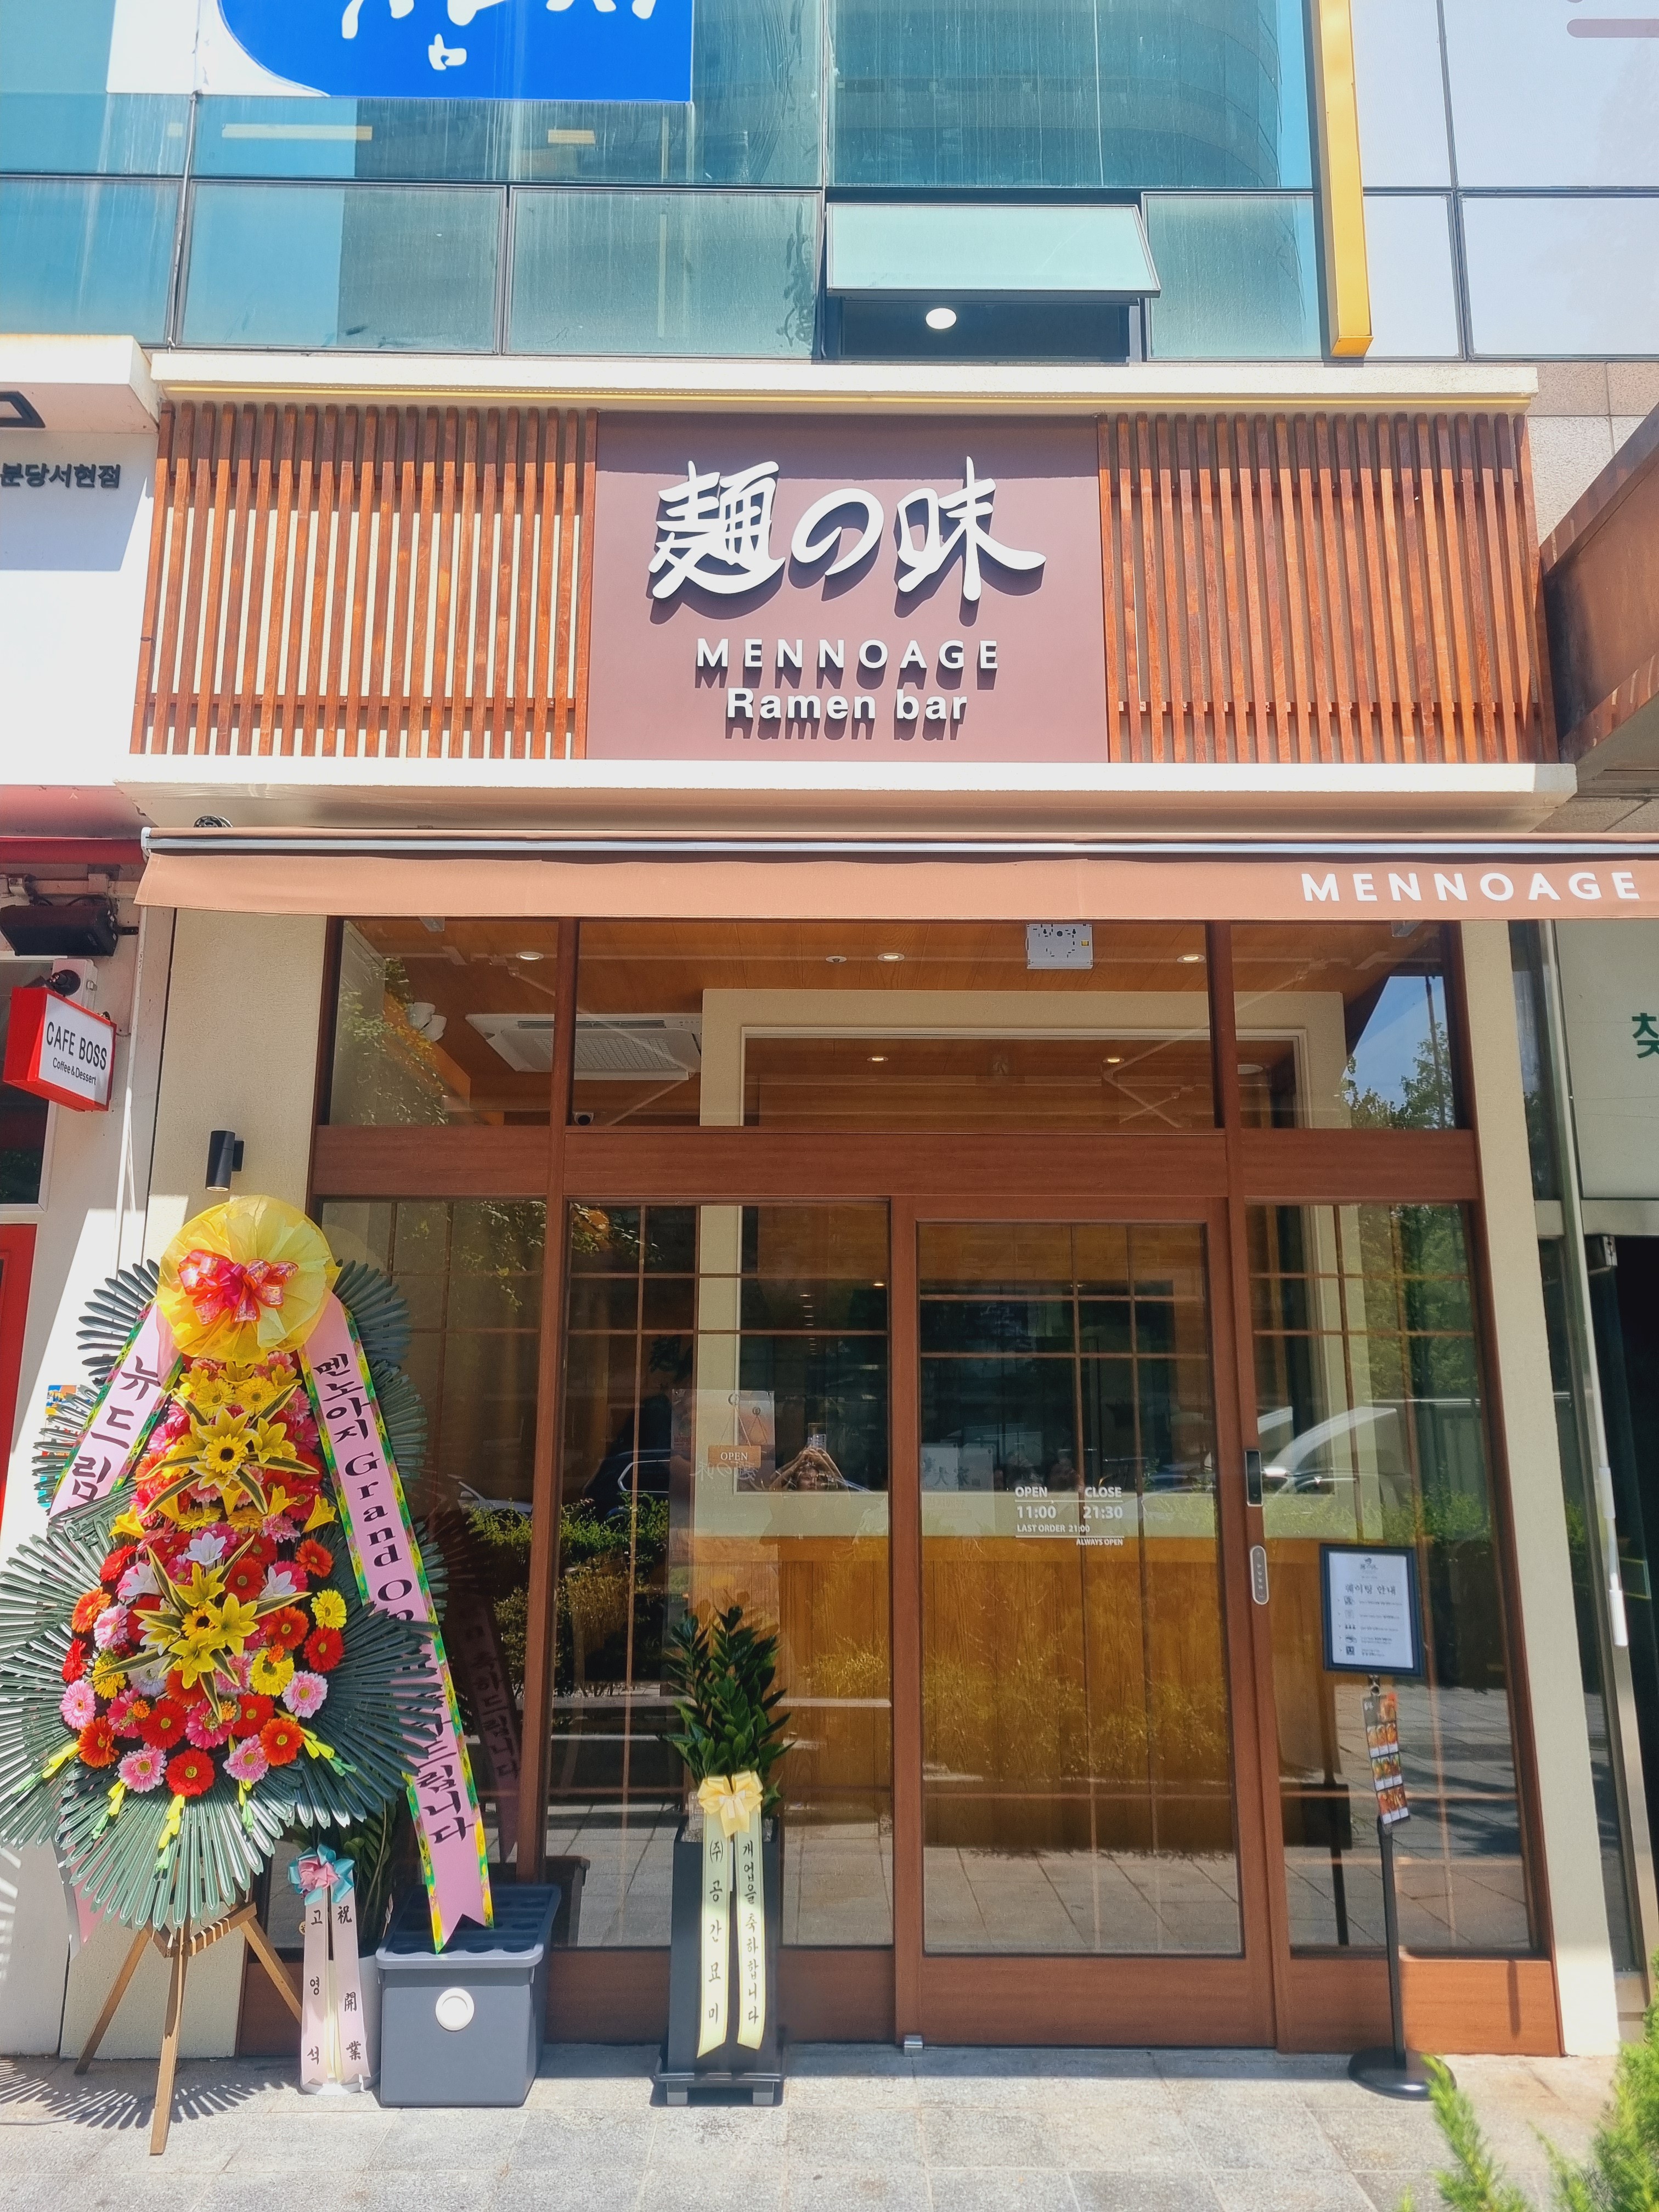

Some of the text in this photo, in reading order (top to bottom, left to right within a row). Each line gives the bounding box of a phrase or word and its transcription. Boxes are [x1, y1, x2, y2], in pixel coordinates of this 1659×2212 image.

[0, 462, 121, 488] 분당서현점
[697, 638, 999, 669] MENNOAGE
[727, 688, 968, 720] Ramen bar
[1301, 871, 1640, 901] MENNOAGE
[46, 1021, 107, 1070] CAFE BOSS
[312, 1352, 371, 1444] 멘노아지
[345, 1451, 403, 1567] Grand
[720, 1451, 748, 1462] OPEN
[1015, 1486, 1122, 1498] OPEN CLOSE
[1017, 1505, 1124, 1519] 11:00 21:30
[1017, 1524, 1091, 1533] LAST ORDER 21:00
[1076, 1538, 1103, 1547] ALWAYS
[1376, 1584, 1396, 1595] 안내
[743, 1840, 759, 2025] 개업을 축하합니다
